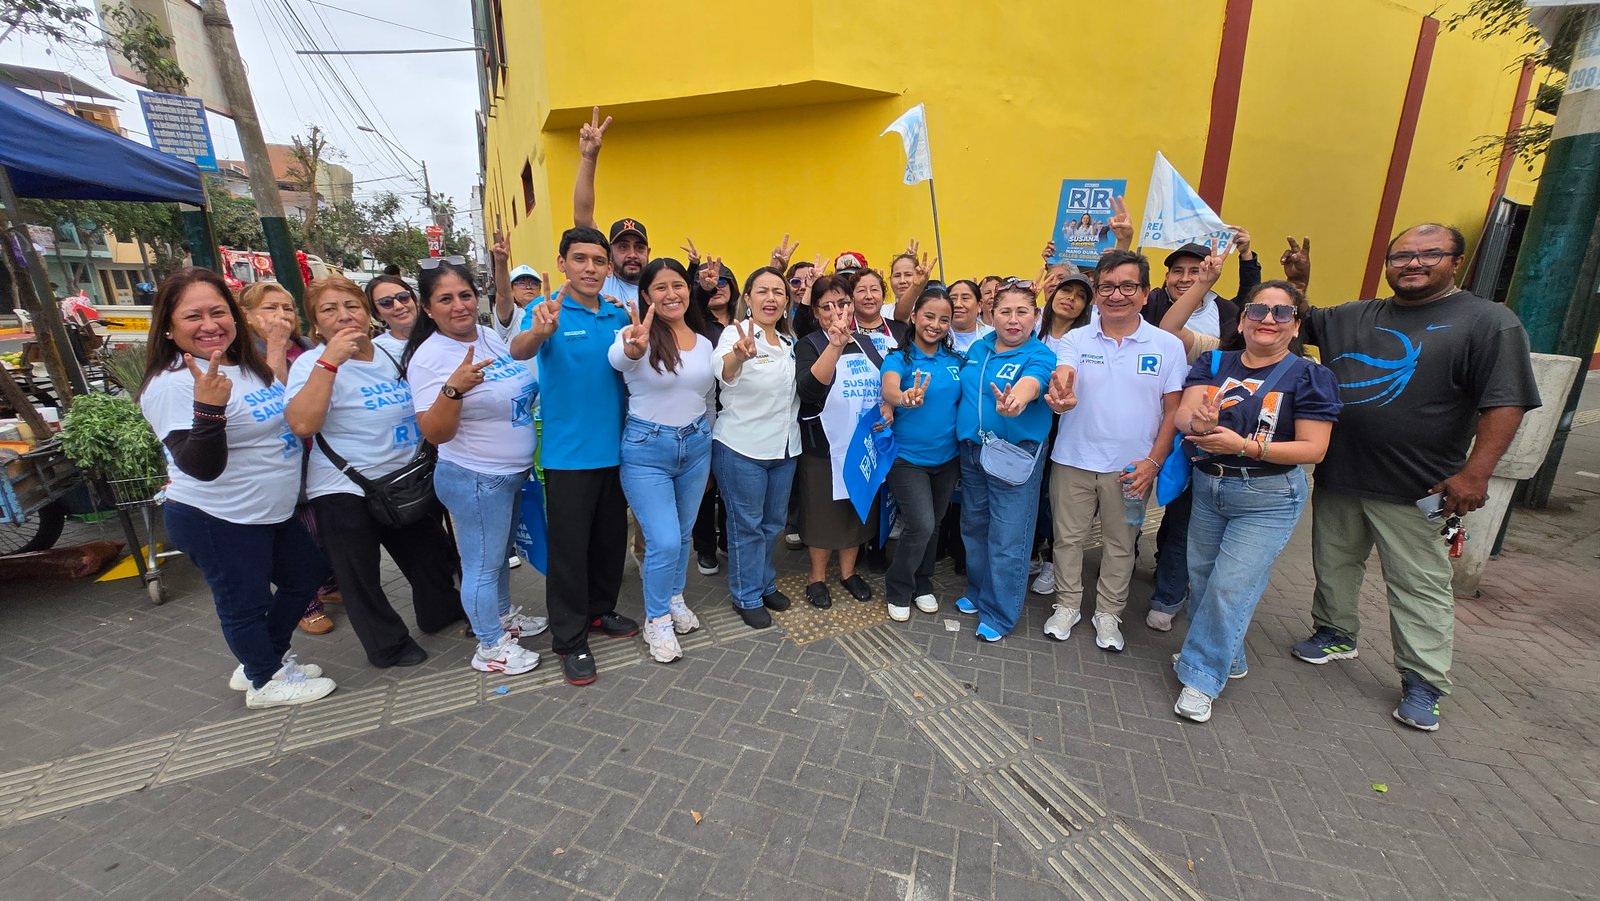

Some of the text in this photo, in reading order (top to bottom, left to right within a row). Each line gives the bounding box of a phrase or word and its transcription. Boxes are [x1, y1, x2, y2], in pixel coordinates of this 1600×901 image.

[1141, 355, 1158, 373] R
[843, 378, 881, 388] SUSANA
[396, 425, 410, 443] R
